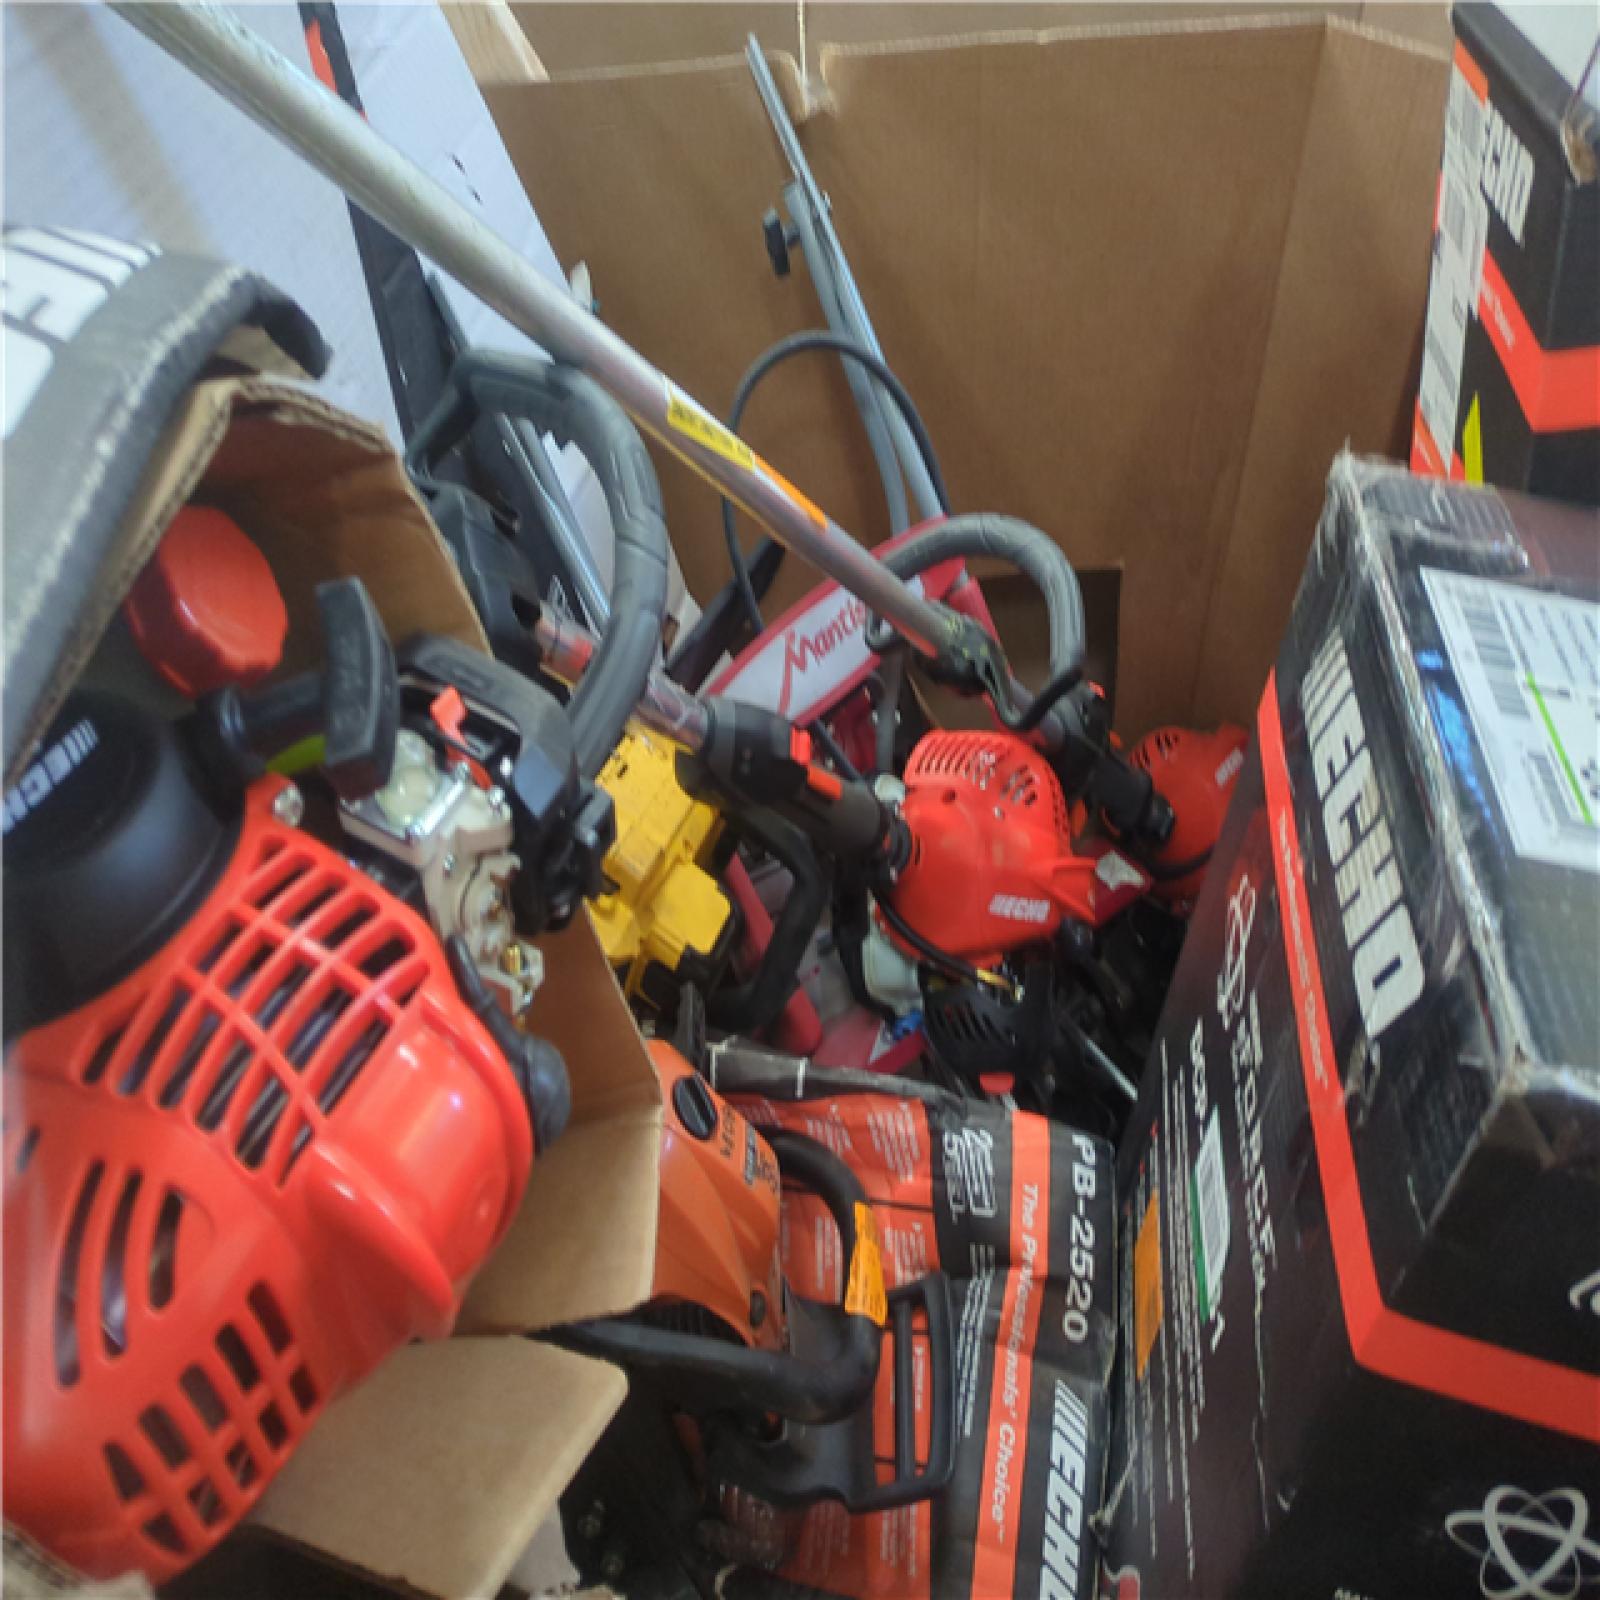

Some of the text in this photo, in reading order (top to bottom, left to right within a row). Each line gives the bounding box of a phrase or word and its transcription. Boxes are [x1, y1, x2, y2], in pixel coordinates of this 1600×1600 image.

[1312, 692, 1426, 1040] ECHO
[1022, 1184, 1039, 1231] The
[1063, 1134, 1096, 1343] PB-2520
